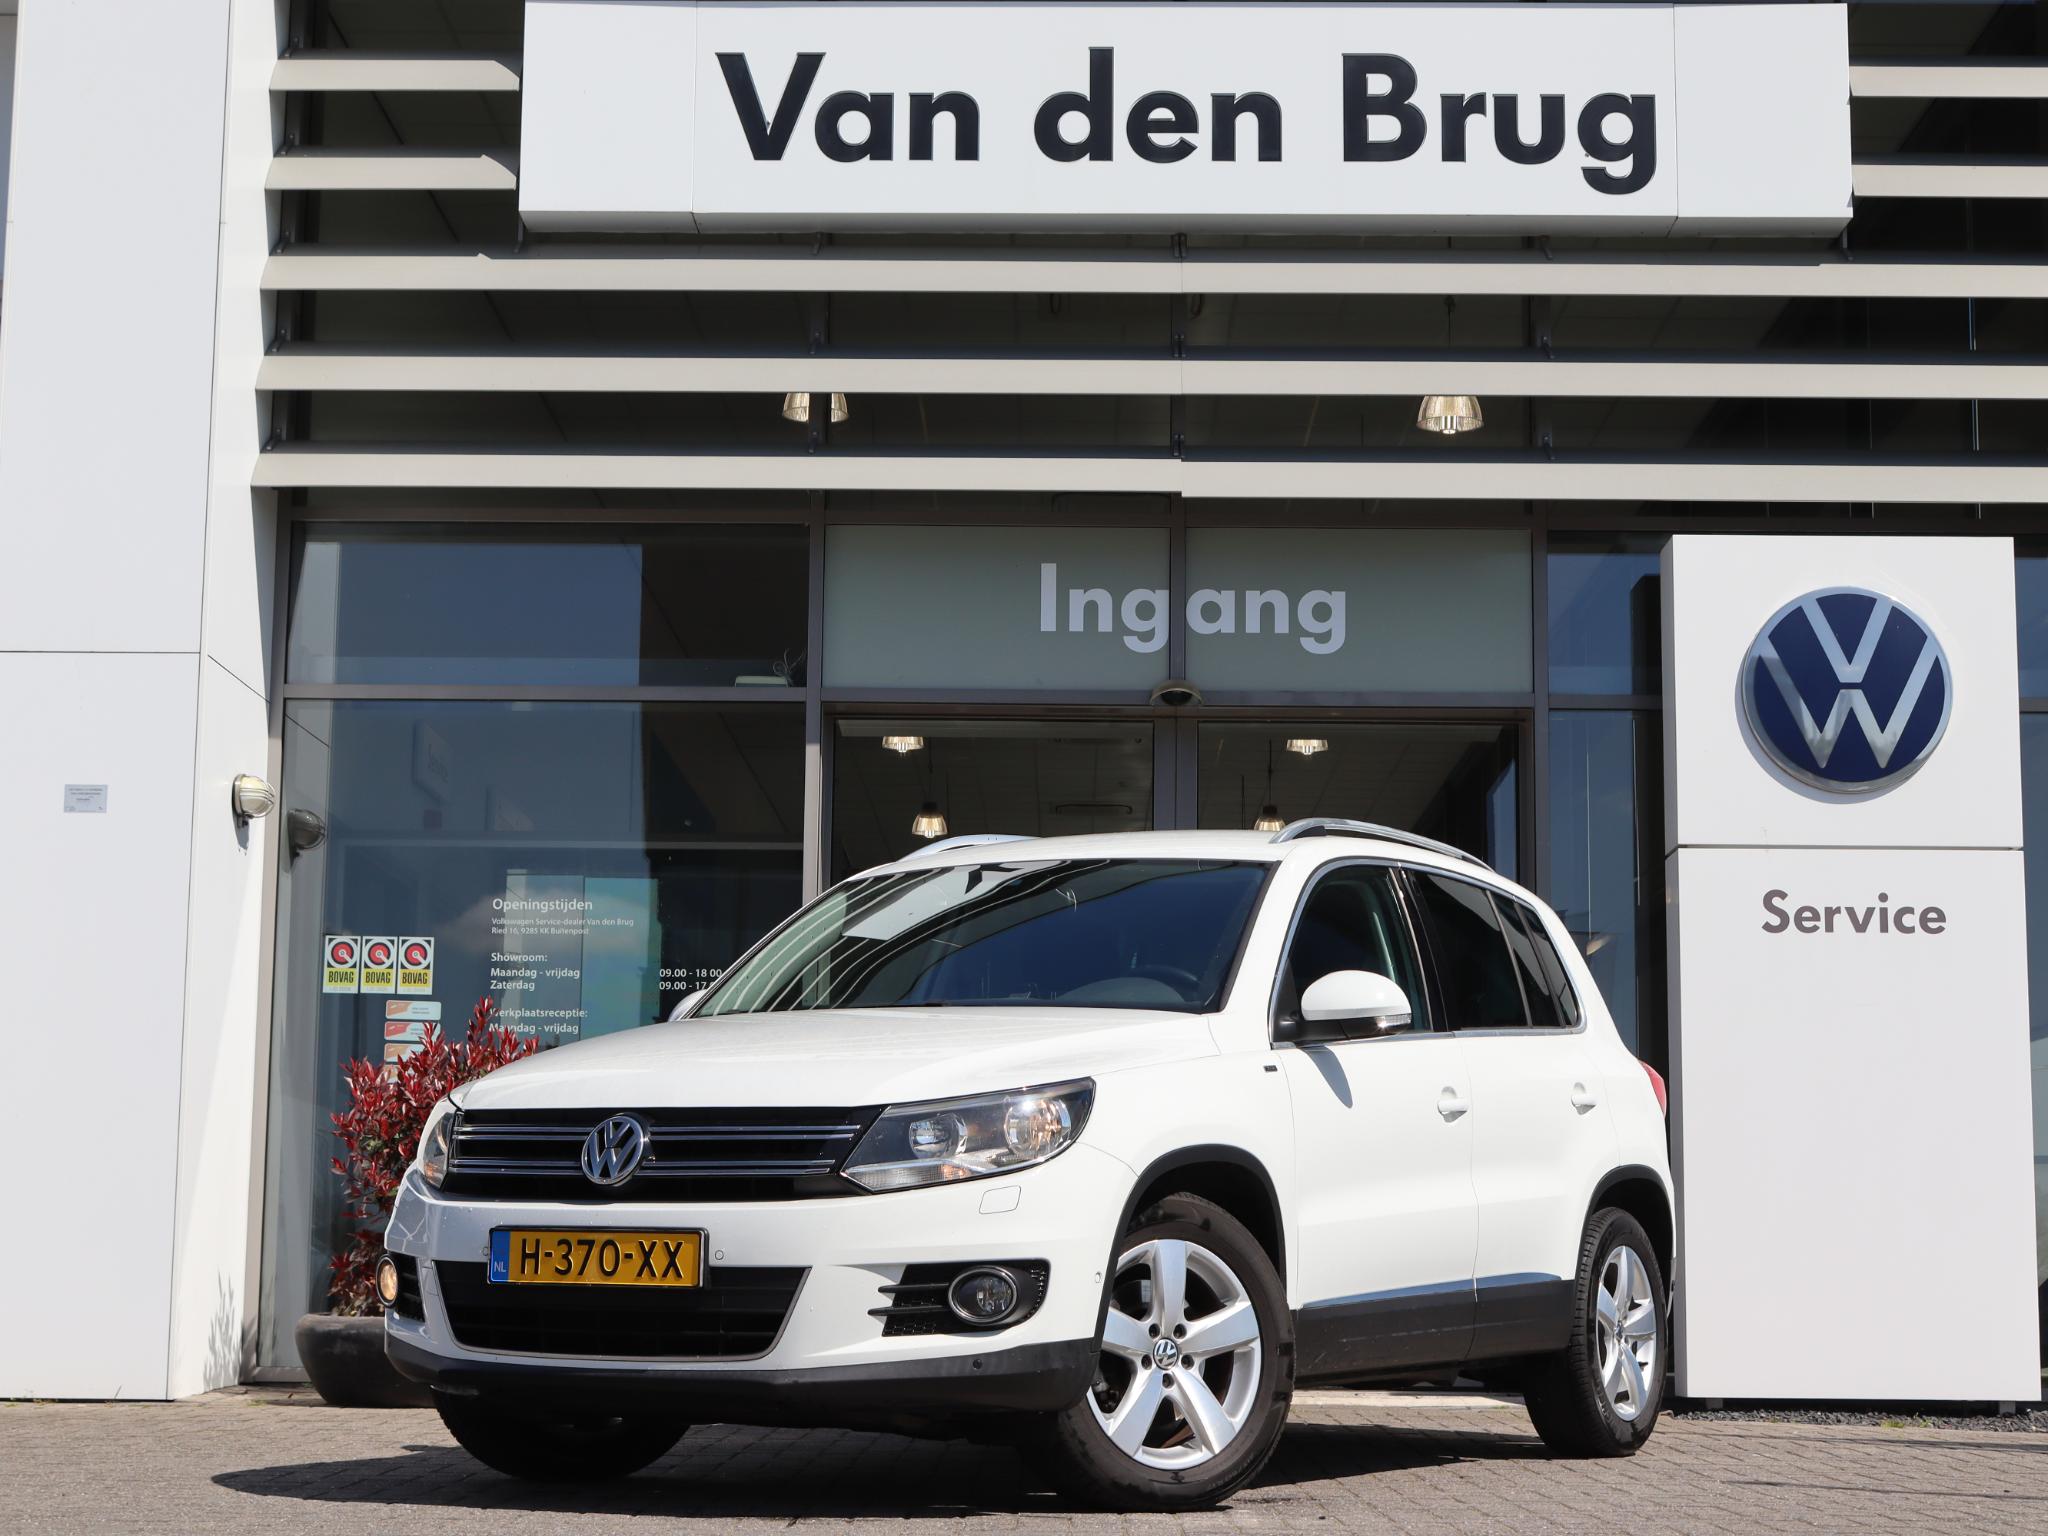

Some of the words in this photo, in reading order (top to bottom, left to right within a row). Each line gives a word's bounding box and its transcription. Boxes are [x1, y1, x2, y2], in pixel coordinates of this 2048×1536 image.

[715, 51, 981, 163] Van
[1033, 46, 1283, 164] den
[1341, 52, 1658, 196] Brug
[1040, 562, 1347, 655] Ingang
[492, 898, 593, 913] Openingstijden
[1761, 888, 1947, 935] Service
[586, 918, 601, 926] Van
[601, 918, 615, 926] den
[616, 918, 634, 928] Brug
[491, 927, 508, 935] Ried
[520, 927, 539, 935] 9285
[540, 927, 550, 935] KK
[490, 952, 548, 962] Showroom:
[328, 970, 355, 984] BOVAG
[365, 971, 391, 984] BOVAG
[402, 972, 428, 985] BOVAG
[490, 968, 537, 979] Maandag
[545, 968, 580, 979] vrijdag
[659, 968, 687, 978] 09.00
[489, 980, 535, 991] Zaterdag
[659, 981, 687, 990] 09.00
[543, 1023, 579, 1034] vrijdag
[520, 1238, 684, 1280] H-370-XX
[493, 1262, 507, 1274] NL
